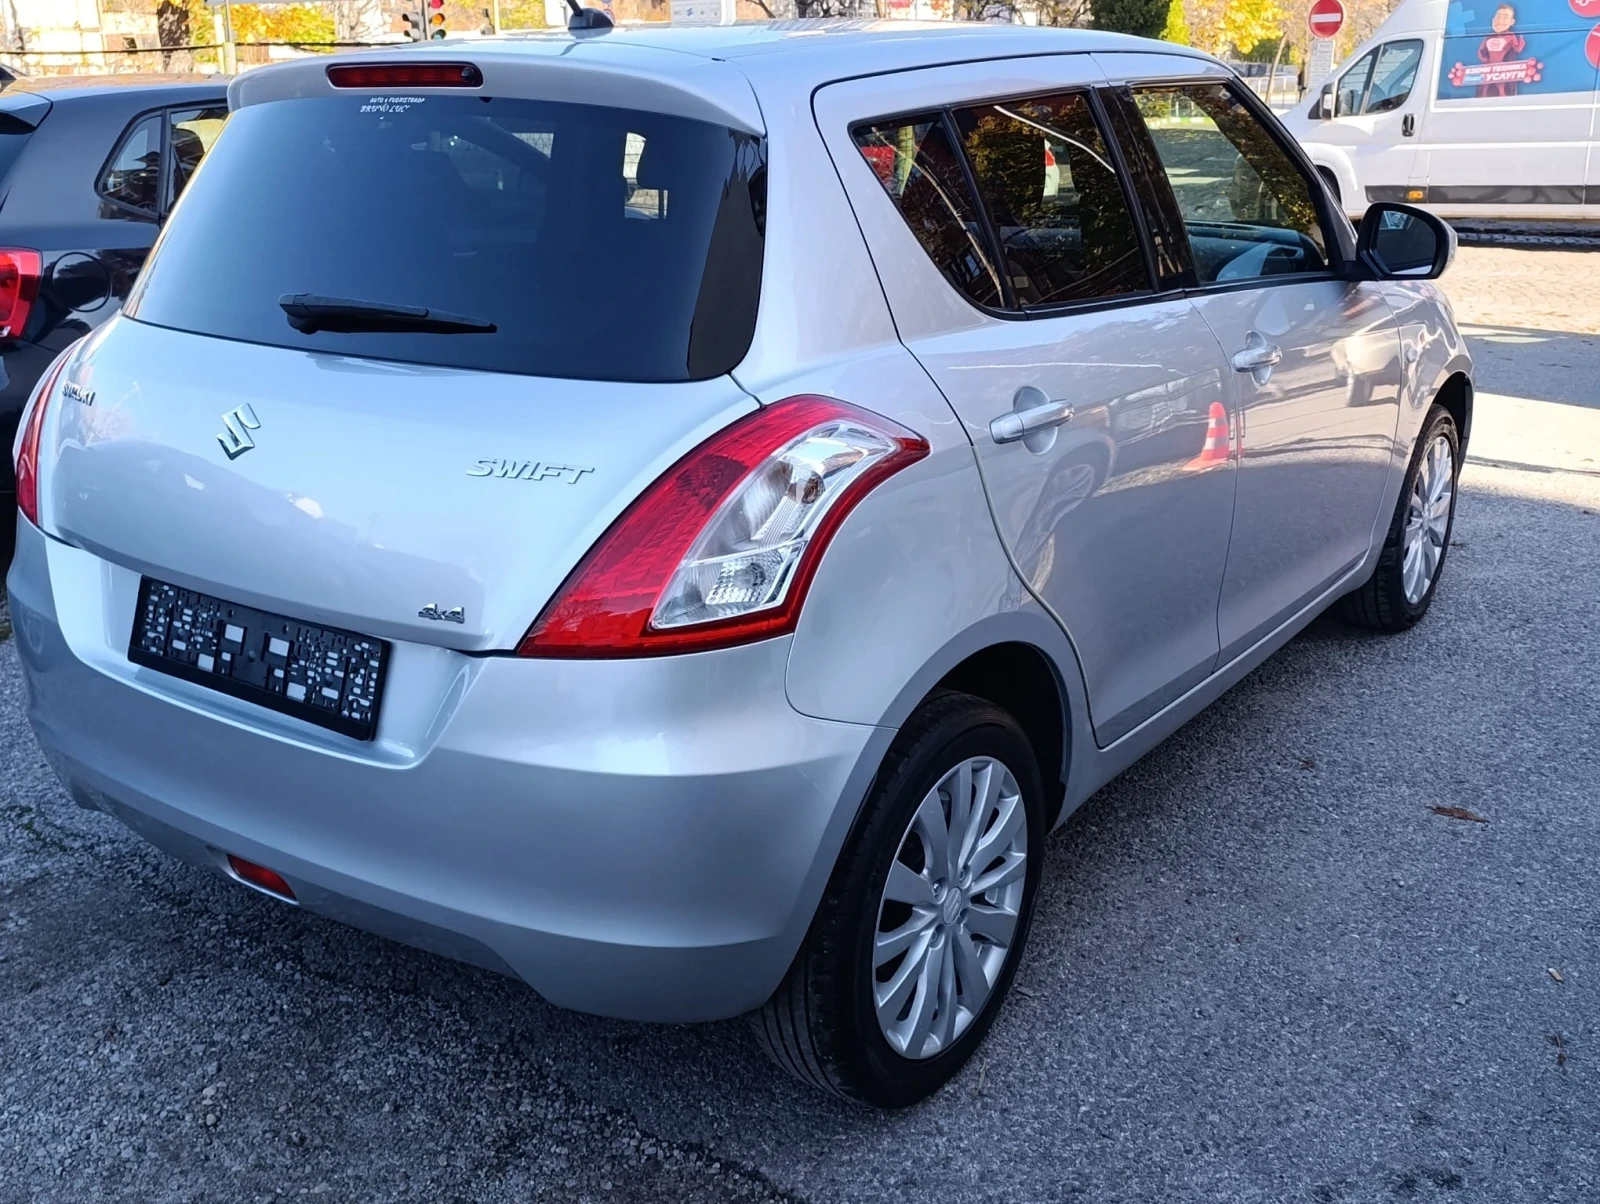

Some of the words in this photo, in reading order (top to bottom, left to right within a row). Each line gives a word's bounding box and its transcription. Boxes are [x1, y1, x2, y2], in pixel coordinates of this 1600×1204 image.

[1485, 70, 1526, 82] УСЛУГИ
[1492, 63, 1527, 72] ТЕХНИКА
[61, 382, 96, 406] SUZUKI
[464, 458, 596, 485] SWIFT
